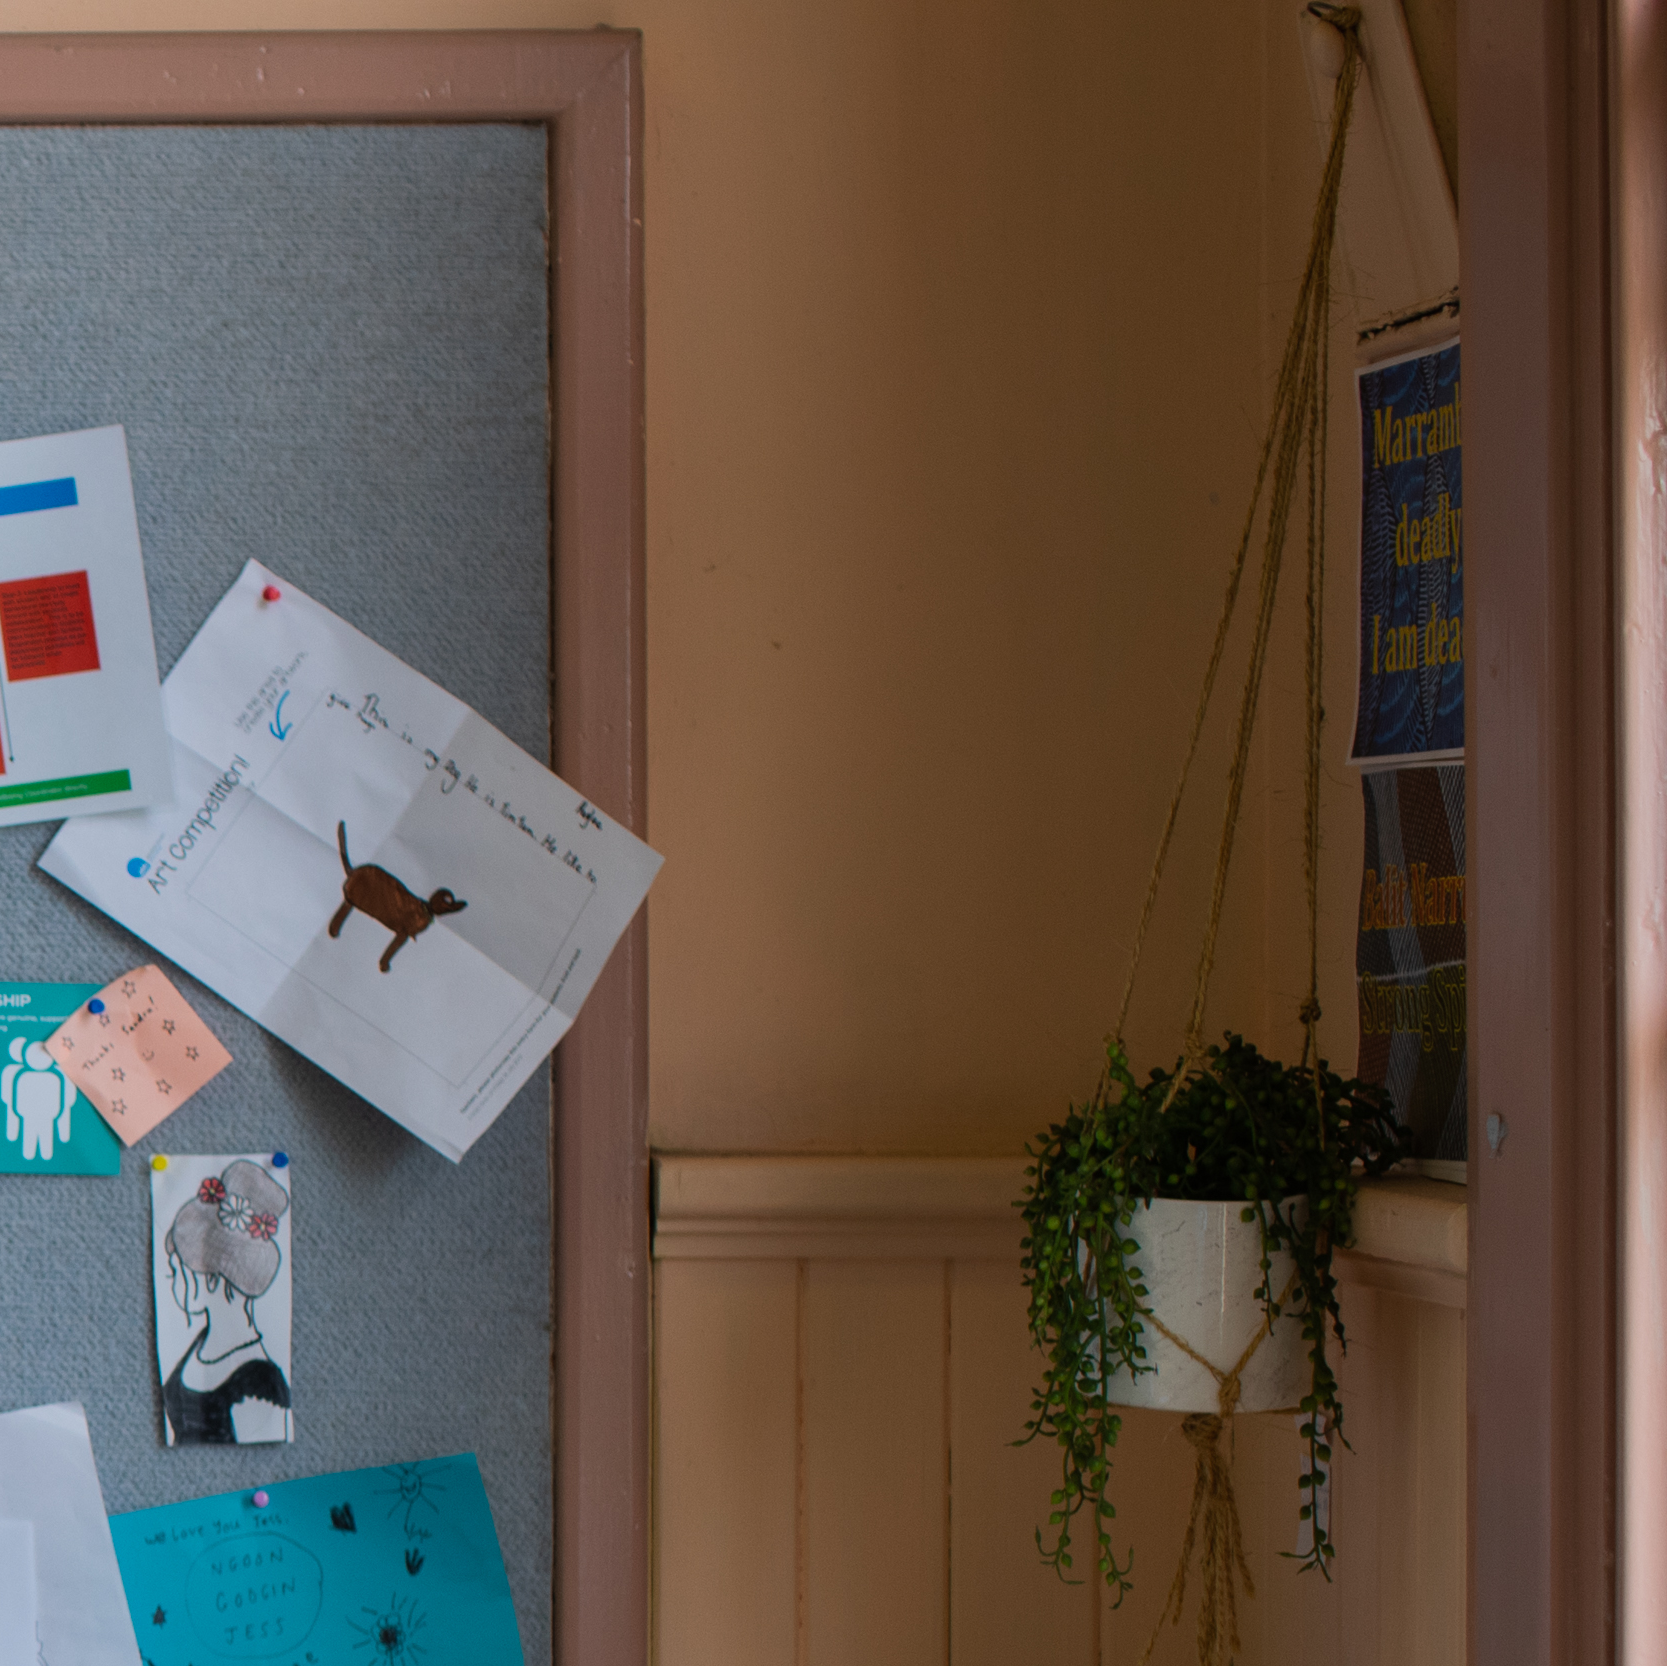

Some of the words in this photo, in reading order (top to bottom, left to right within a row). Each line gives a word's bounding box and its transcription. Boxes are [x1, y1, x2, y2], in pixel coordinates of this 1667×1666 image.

[1394, 490, 1463, 572] deadly
[1371, 614, 1381, 675] I
[1382, 626, 1420, 672] am
[1421, 610, 1466, 667] dea
[147, 858, 179, 895] Art
[168, 752, 251, 862] Competition!
[1361, 860, 1408, 932] Balit
[223, 1616, 286, 1646] JESS
